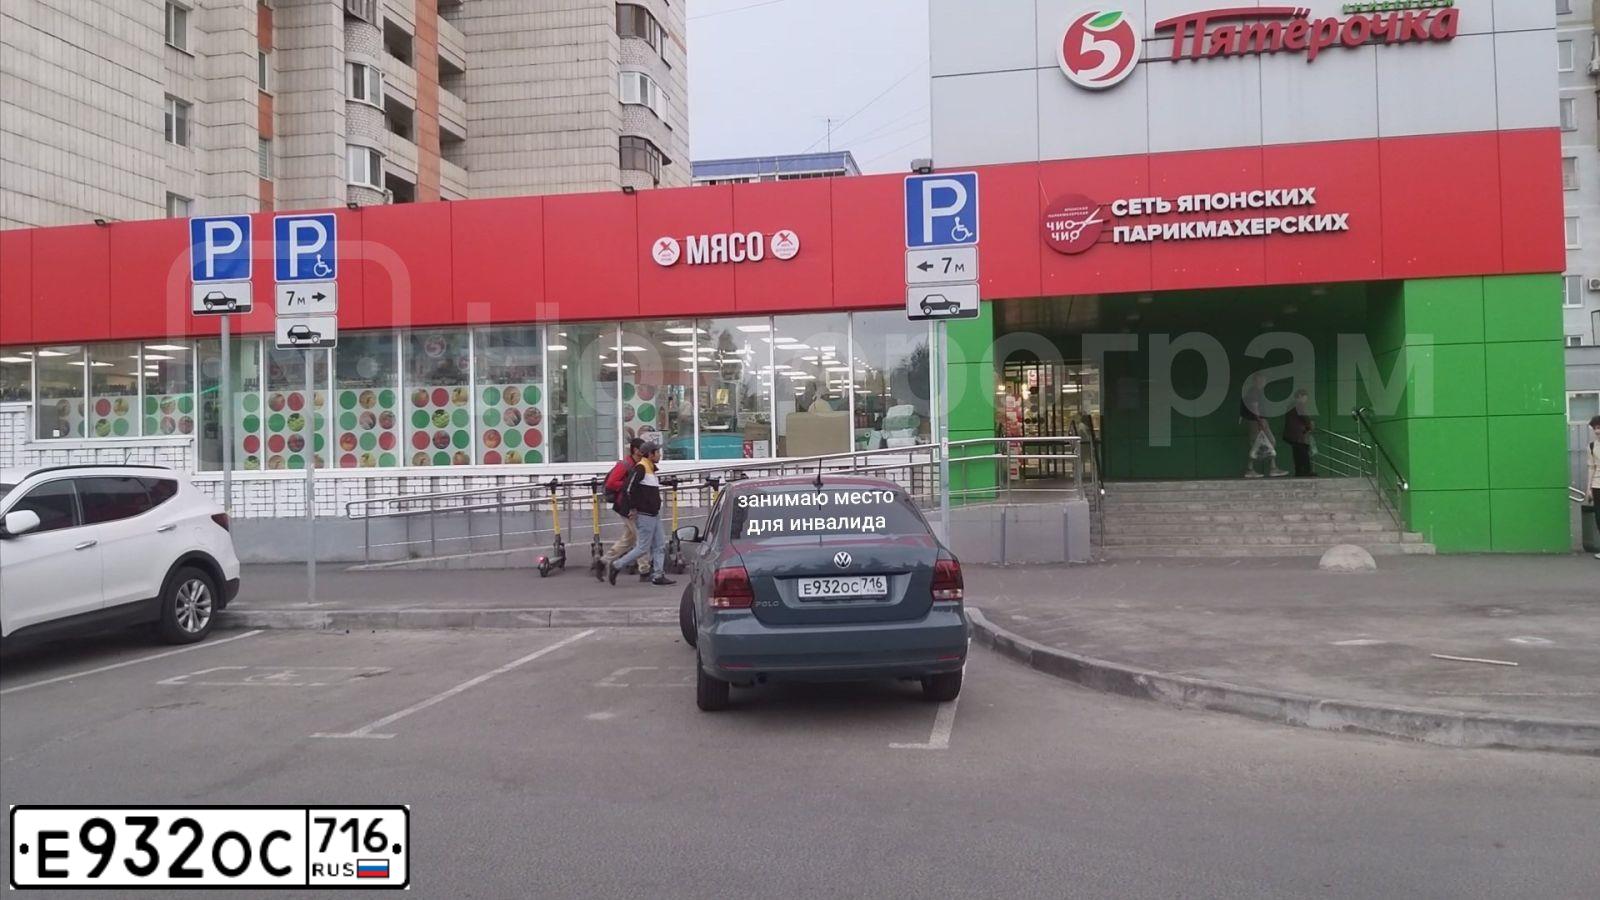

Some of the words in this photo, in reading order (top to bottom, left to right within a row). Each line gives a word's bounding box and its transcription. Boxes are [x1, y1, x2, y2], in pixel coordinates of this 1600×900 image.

[1154, 7, 1460, 62] Пятёрочка
[922, 178, 968, 243] P
[1111, 197, 1171, 217] СЕТЬ
[1177, 187, 1316, 213] ЯПОНСКИХ
[204, 220, 243, 278] P
[289, 219, 328, 278] P
[686, 231, 764, 265] МЯСО
[1113, 213, 1350, 243] ПАРИКМАХЕРСКИХ
[861, 577, 883, 590] 716
